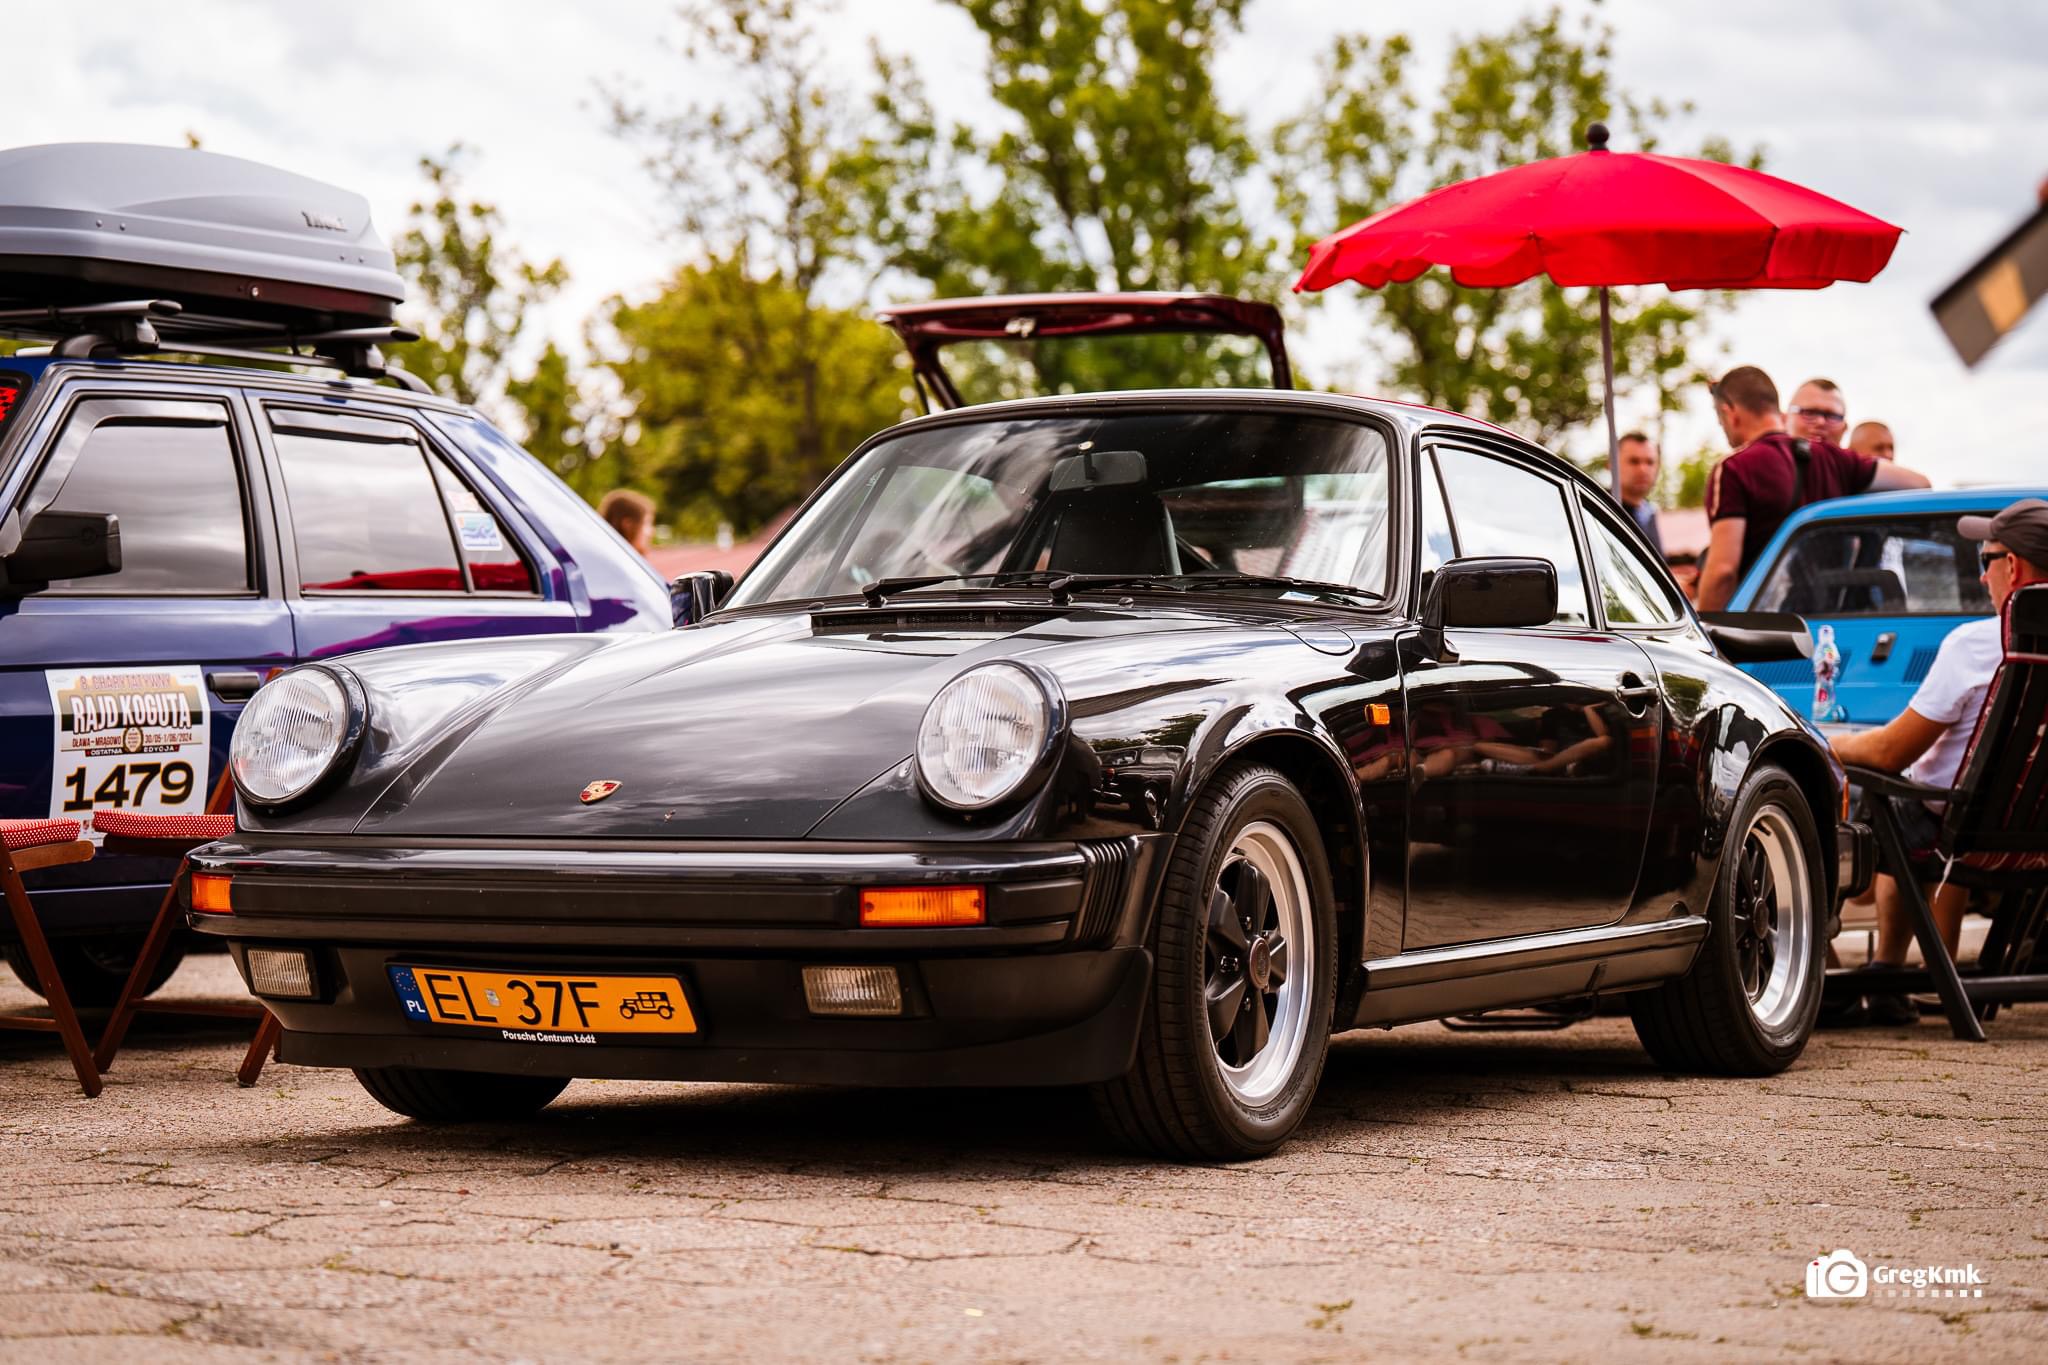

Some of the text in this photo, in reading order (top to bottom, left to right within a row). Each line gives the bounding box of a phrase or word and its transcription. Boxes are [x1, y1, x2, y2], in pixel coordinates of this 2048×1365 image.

[70, 691, 193, 734] RAJD KOGUTA
[64, 761, 194, 812] 1479
[406, 1000, 425, 1013] PL
[424, 973, 600, 1028] EL 37F
[502, 1030, 596, 1044] Porsche Centrum Łódź
